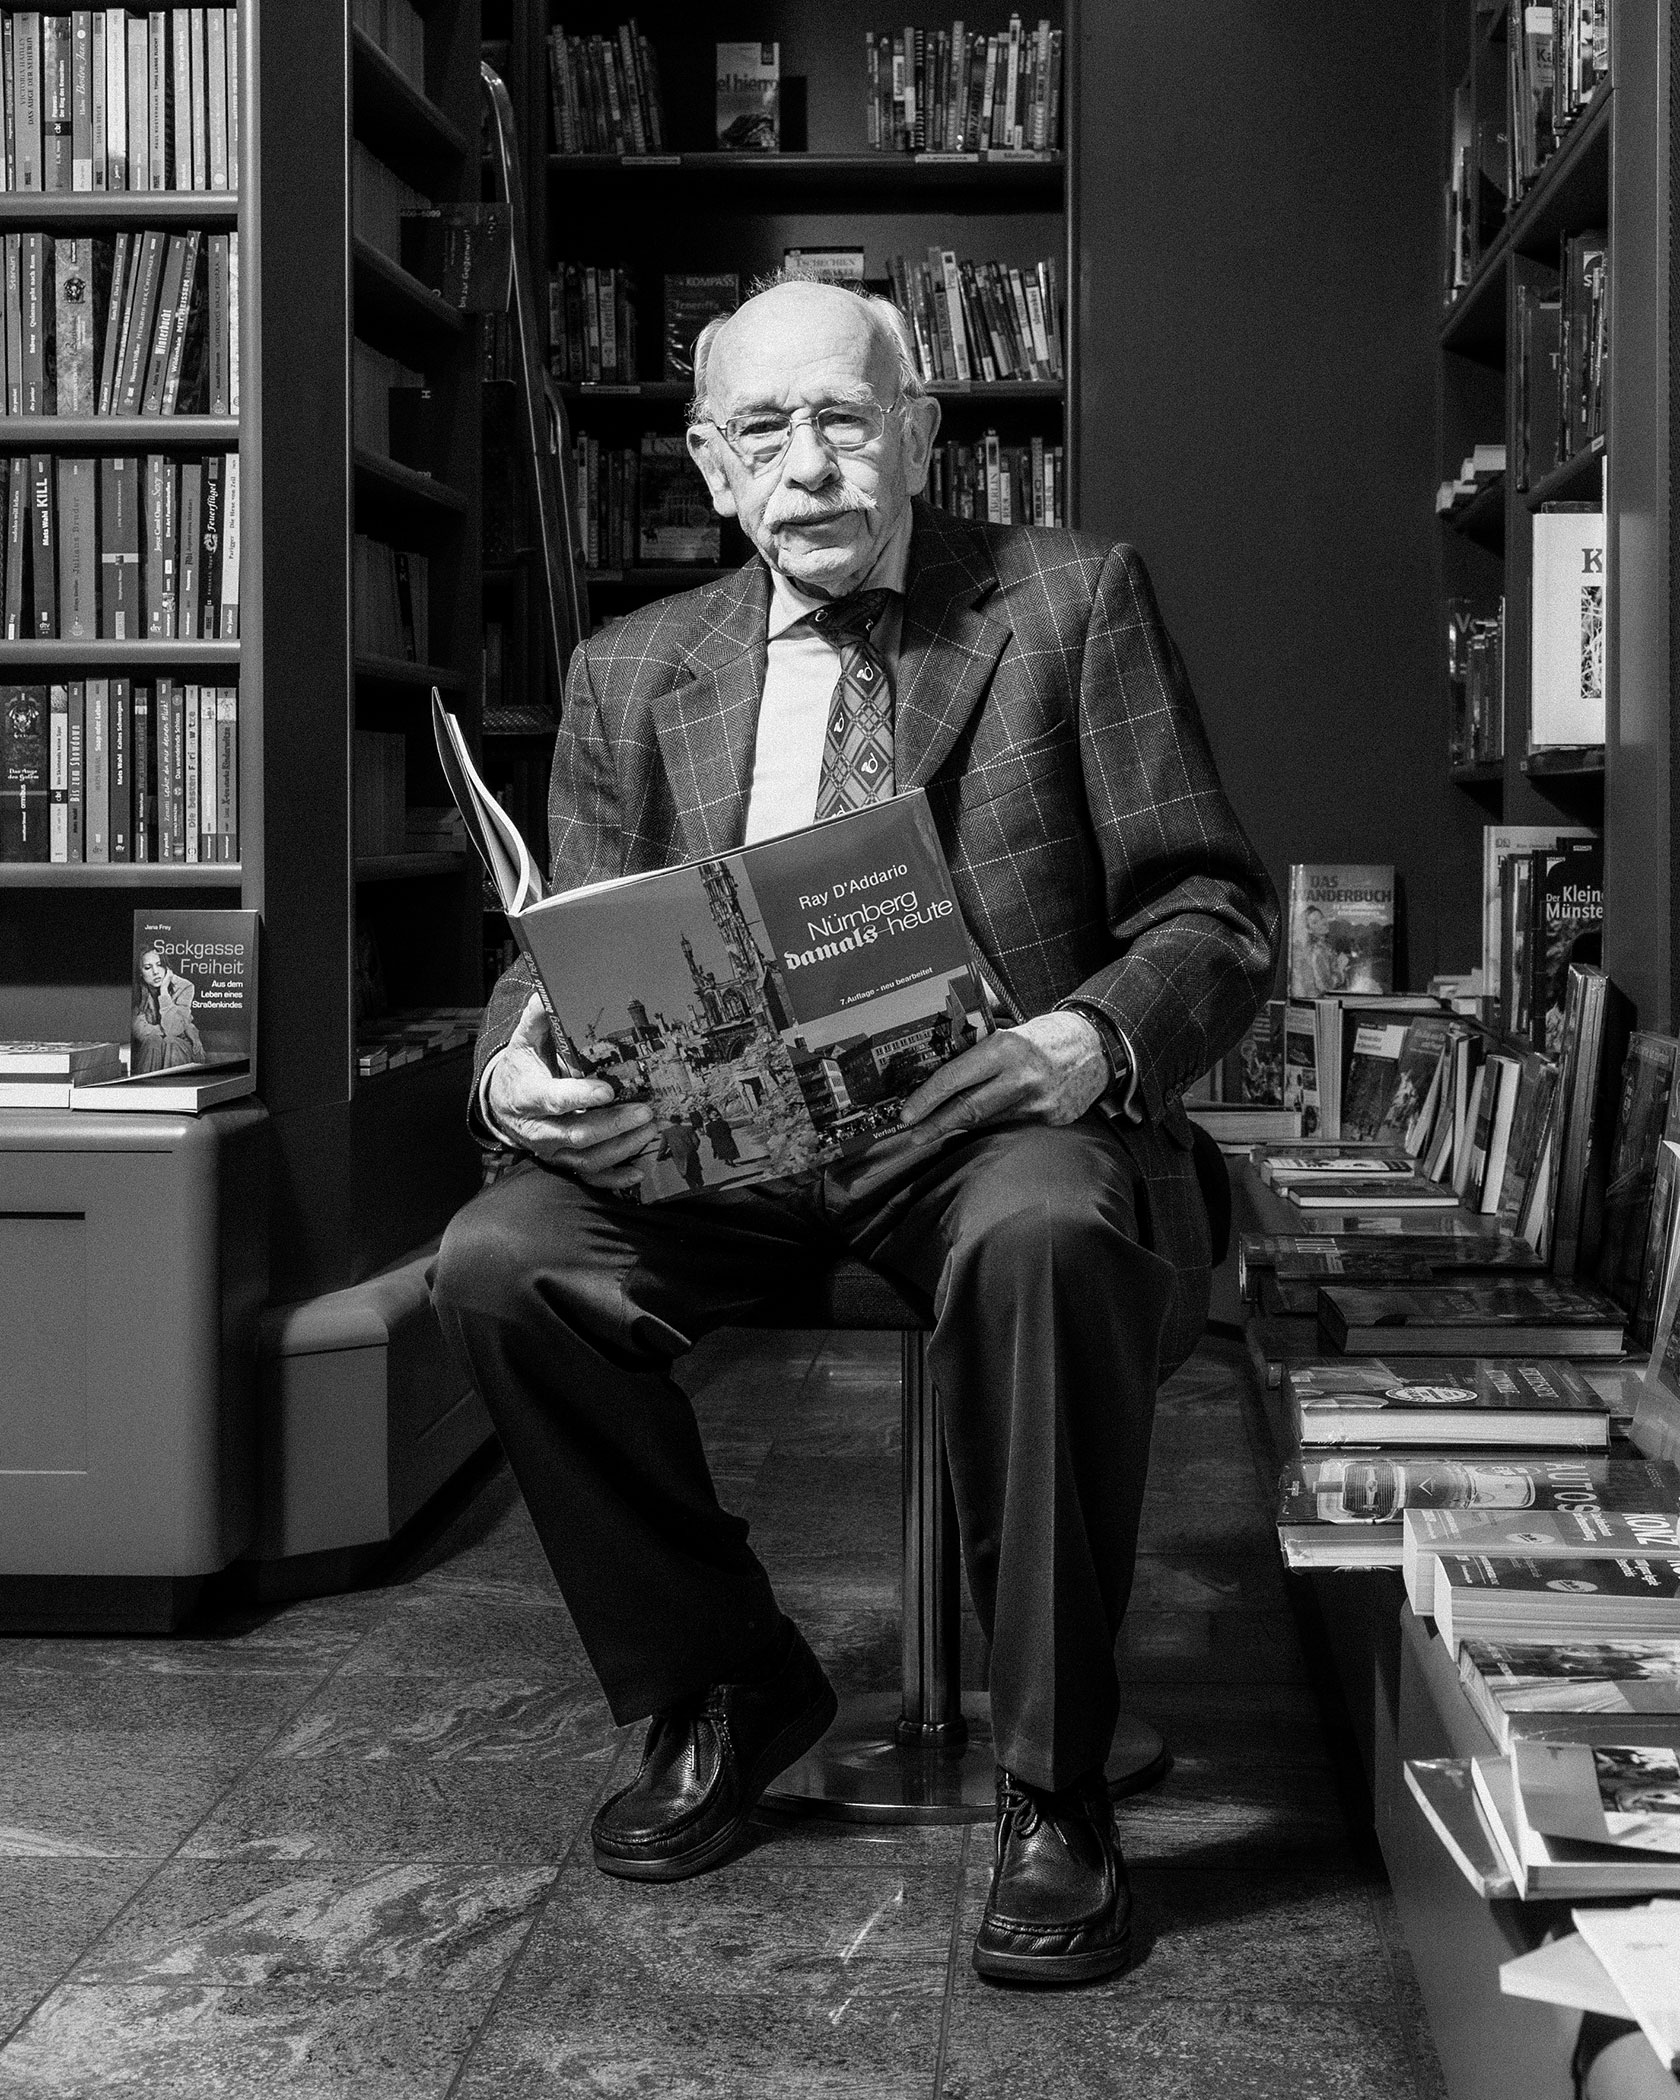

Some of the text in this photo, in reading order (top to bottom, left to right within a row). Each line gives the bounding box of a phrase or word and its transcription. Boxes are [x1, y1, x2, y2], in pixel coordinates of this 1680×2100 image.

[155, 309, 171, 354] Winterbucht
[176, 317, 184, 332] MIT
[36, 478, 48, 507] KILL
[152, 477, 163, 497] Sexy
[989, 472, 1000, 512] BERLIN
[207, 481, 218, 533] Feuerflügel
[70, 725, 80, 802] Bis zum Showdown
[188, 775, 196, 828] Die besten
[798, 862, 908, 910] Ray D'Addario
[1305, 889, 1392, 902] ANDERBUCH
[1546, 893, 1560, 902] Der
[807, 890, 918, 941] Nürnberg
[153, 940, 244, 958] Sackgasse
[180, 959, 244, 974] Freiheit
[880, 981, 895, 992] neu
[895, 967, 933, 987] bearbeitet
[212, 980, 243, 988] Aus dem
[192, 1001, 243, 1009] Straßenkindes
[872, 1125, 897, 1140] Verlag
[1544, 1462, 1601, 1512] AUTOS
[1621, 1513, 1678, 1544] KONZ
